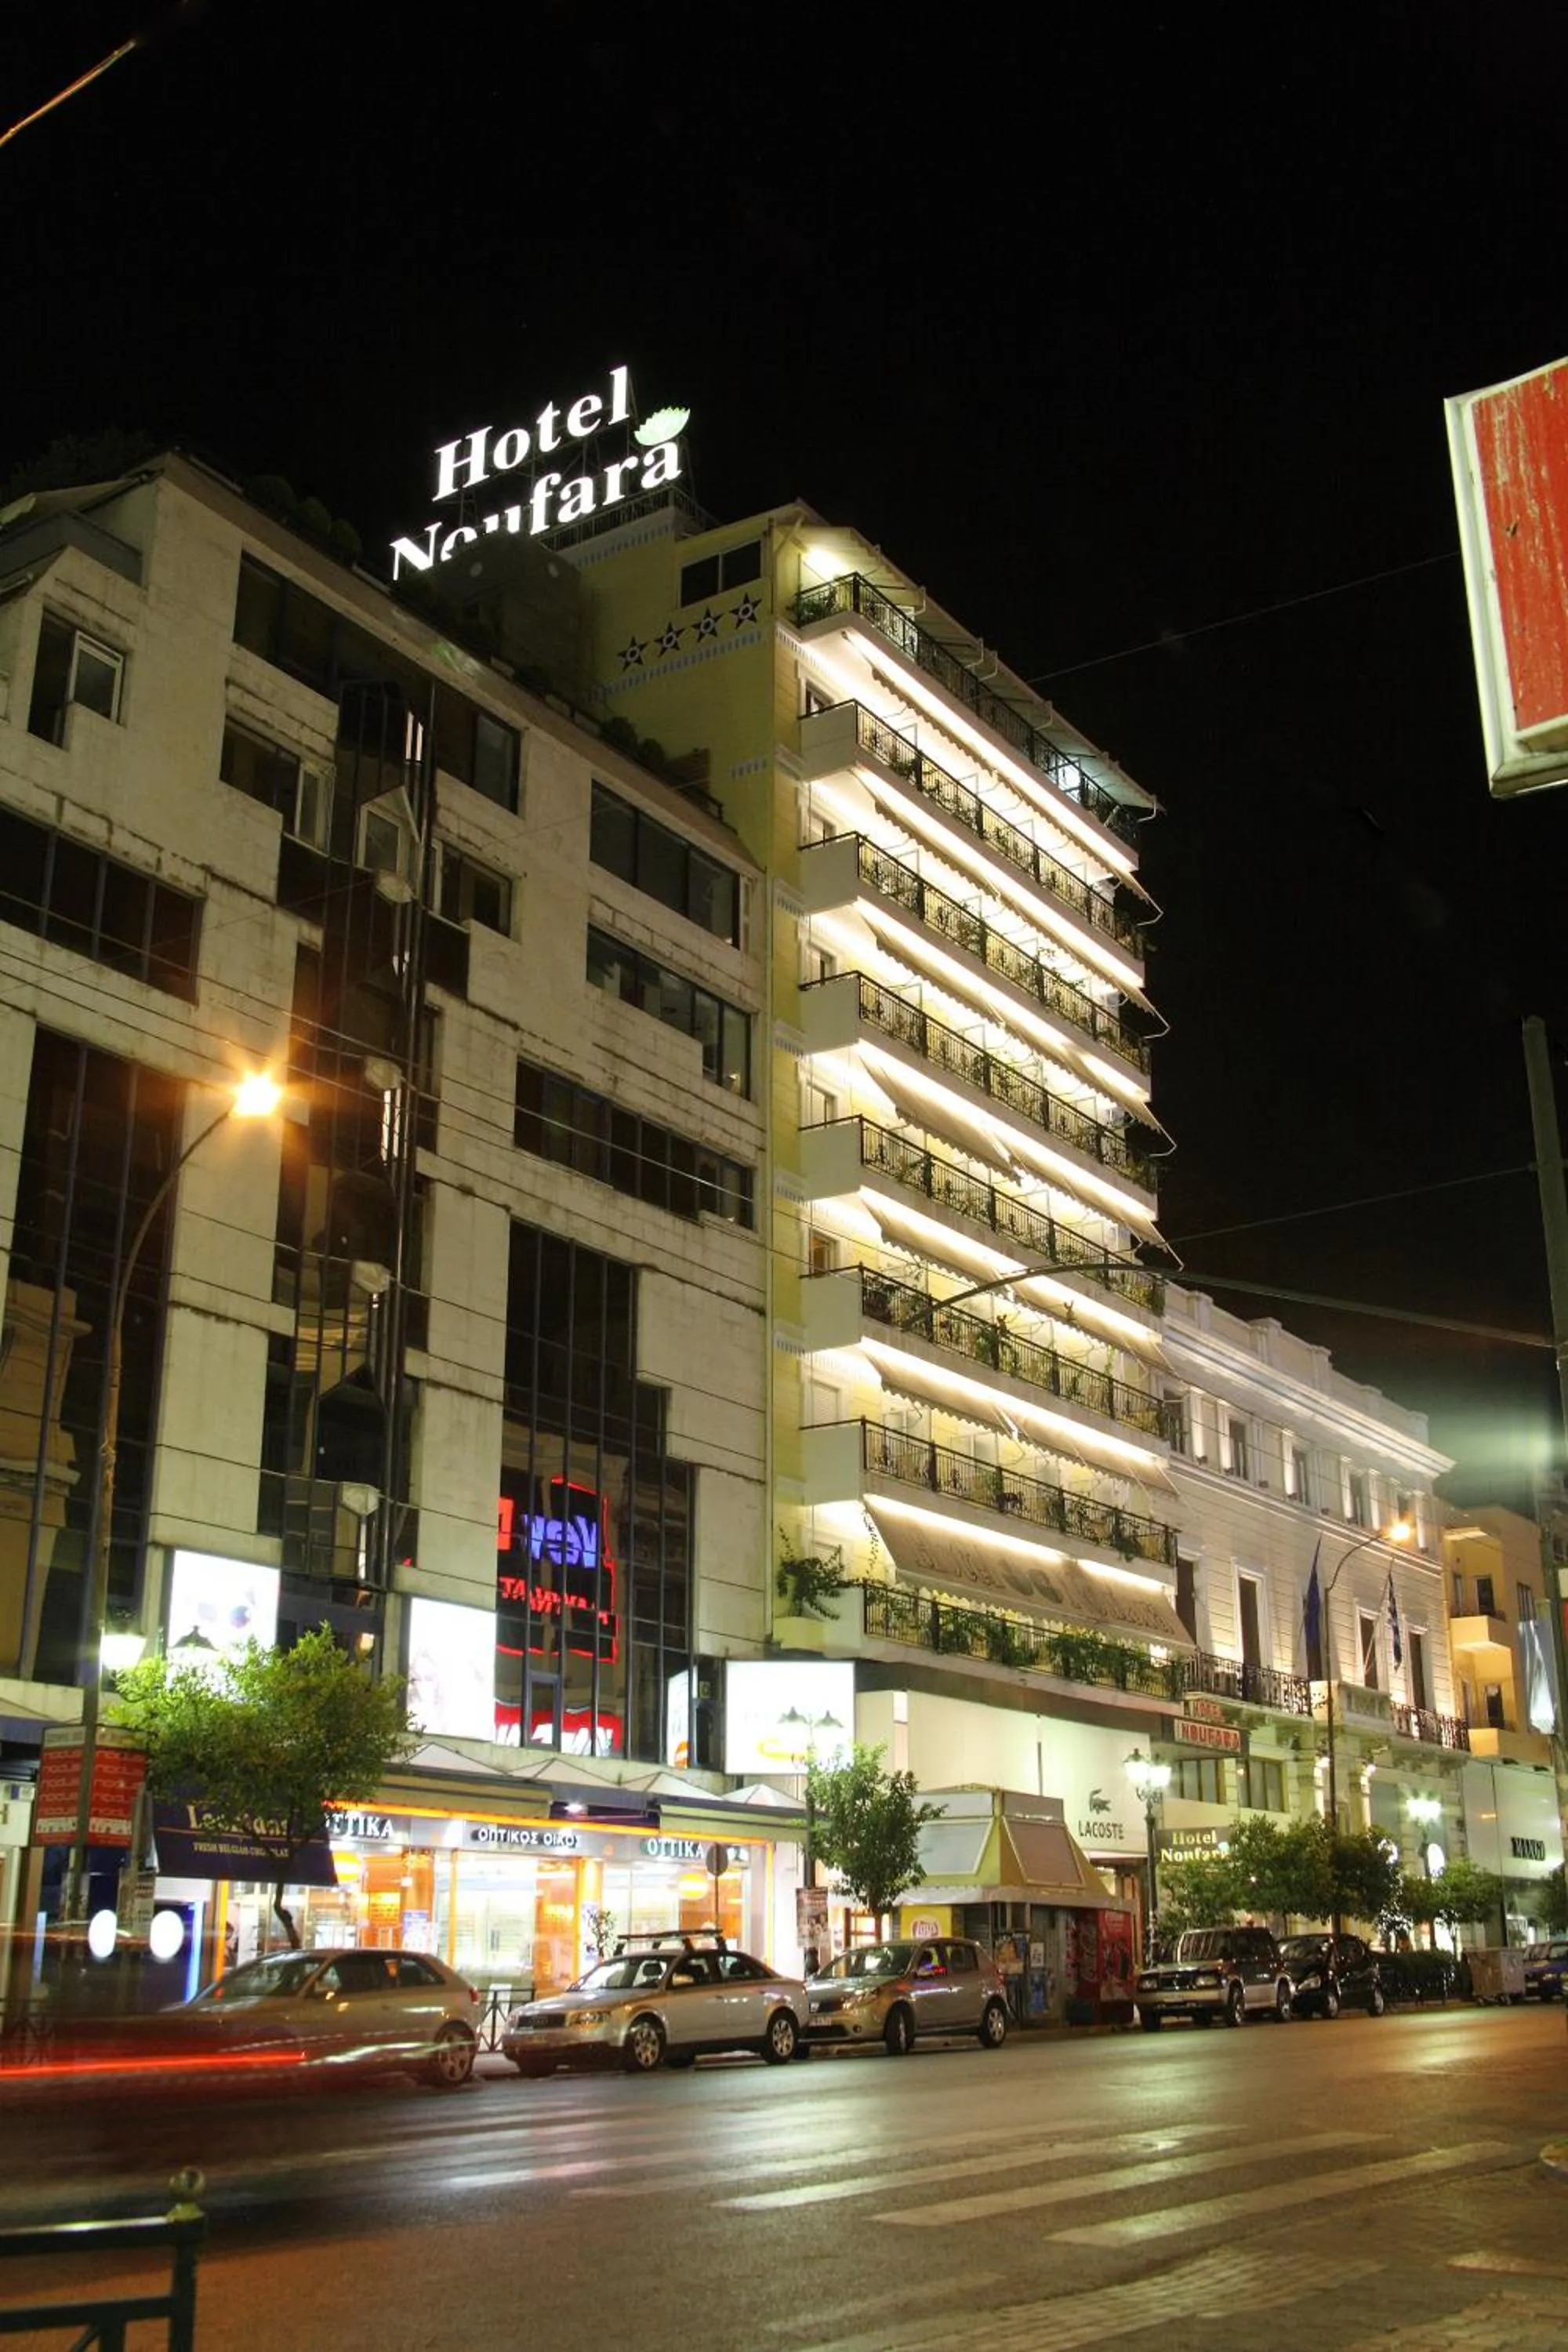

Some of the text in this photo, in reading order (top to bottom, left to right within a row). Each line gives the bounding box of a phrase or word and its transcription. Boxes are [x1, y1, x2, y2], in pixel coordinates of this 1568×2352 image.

[431, 365, 630, 503] Hotel
[1078, 1820, 1124, 1840] LACOSTE
[1172, 1829, 1217, 1846] Hotel
